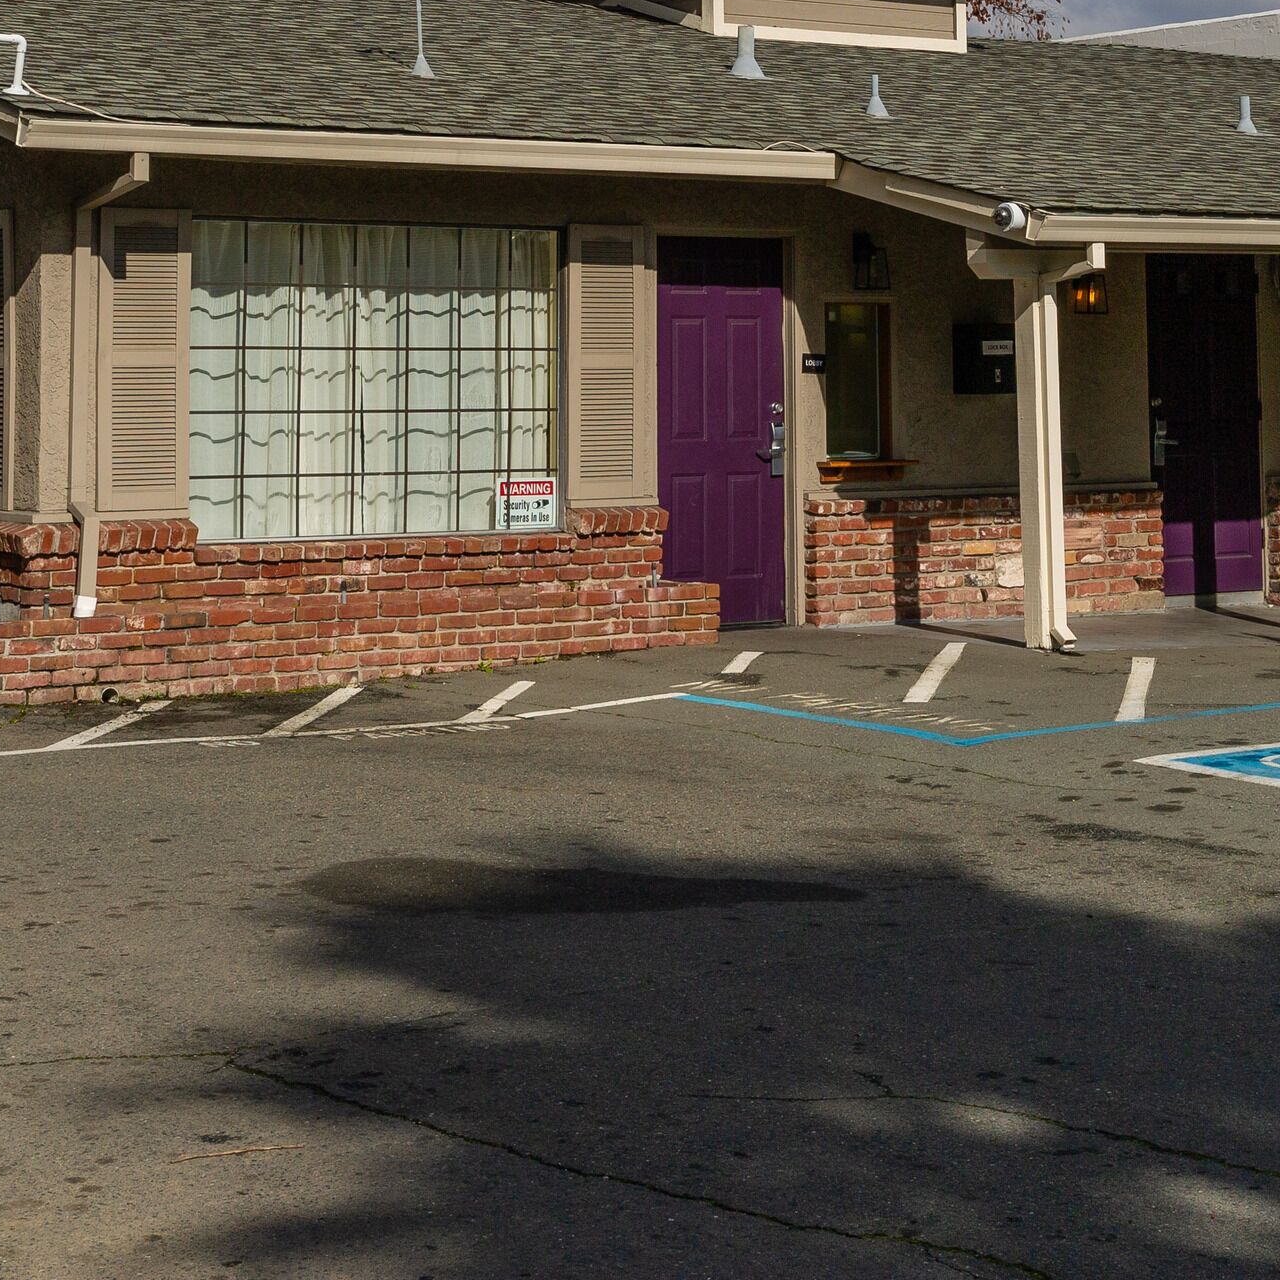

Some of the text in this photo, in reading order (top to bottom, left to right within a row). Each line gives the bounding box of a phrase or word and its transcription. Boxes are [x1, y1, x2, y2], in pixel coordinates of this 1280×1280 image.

[805, 359, 823, 367] LOBBY
[503, 499, 530, 511] Scurity
[503, 513, 530, 523] Cmeras
[538, 512, 550, 522] Use
